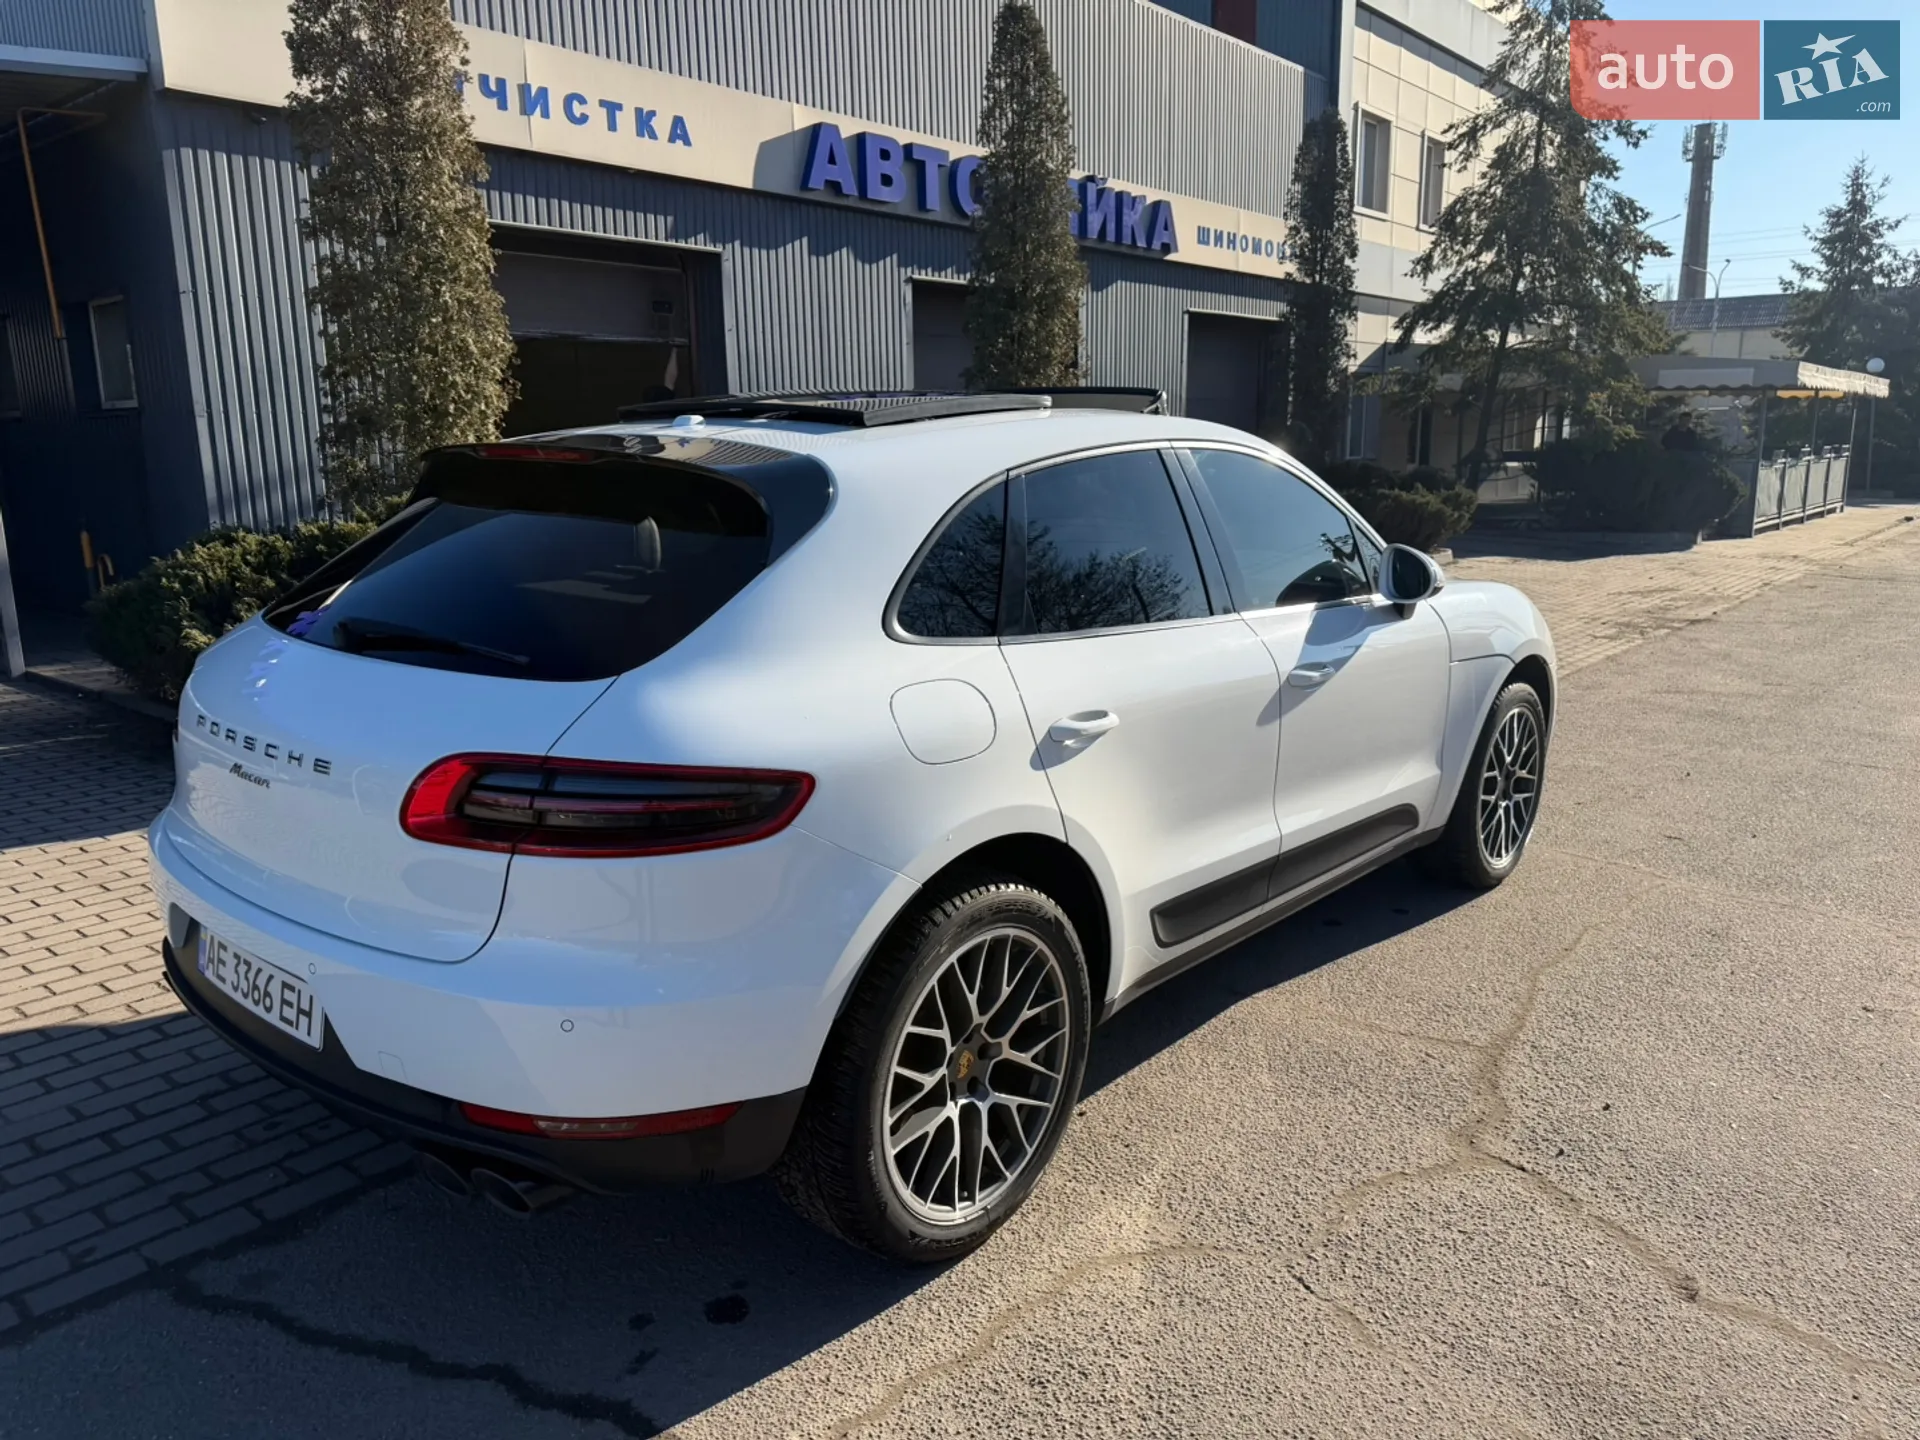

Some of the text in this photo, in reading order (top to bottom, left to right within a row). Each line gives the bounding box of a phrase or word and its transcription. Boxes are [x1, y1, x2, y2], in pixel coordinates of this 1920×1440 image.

[454, 70, 692, 148] ЧИСТКА
[196, 713, 332, 777] PORSCHE
[229, 761, 272, 790] Macan
[206, 933, 314, 1038] AE 3366 EH
